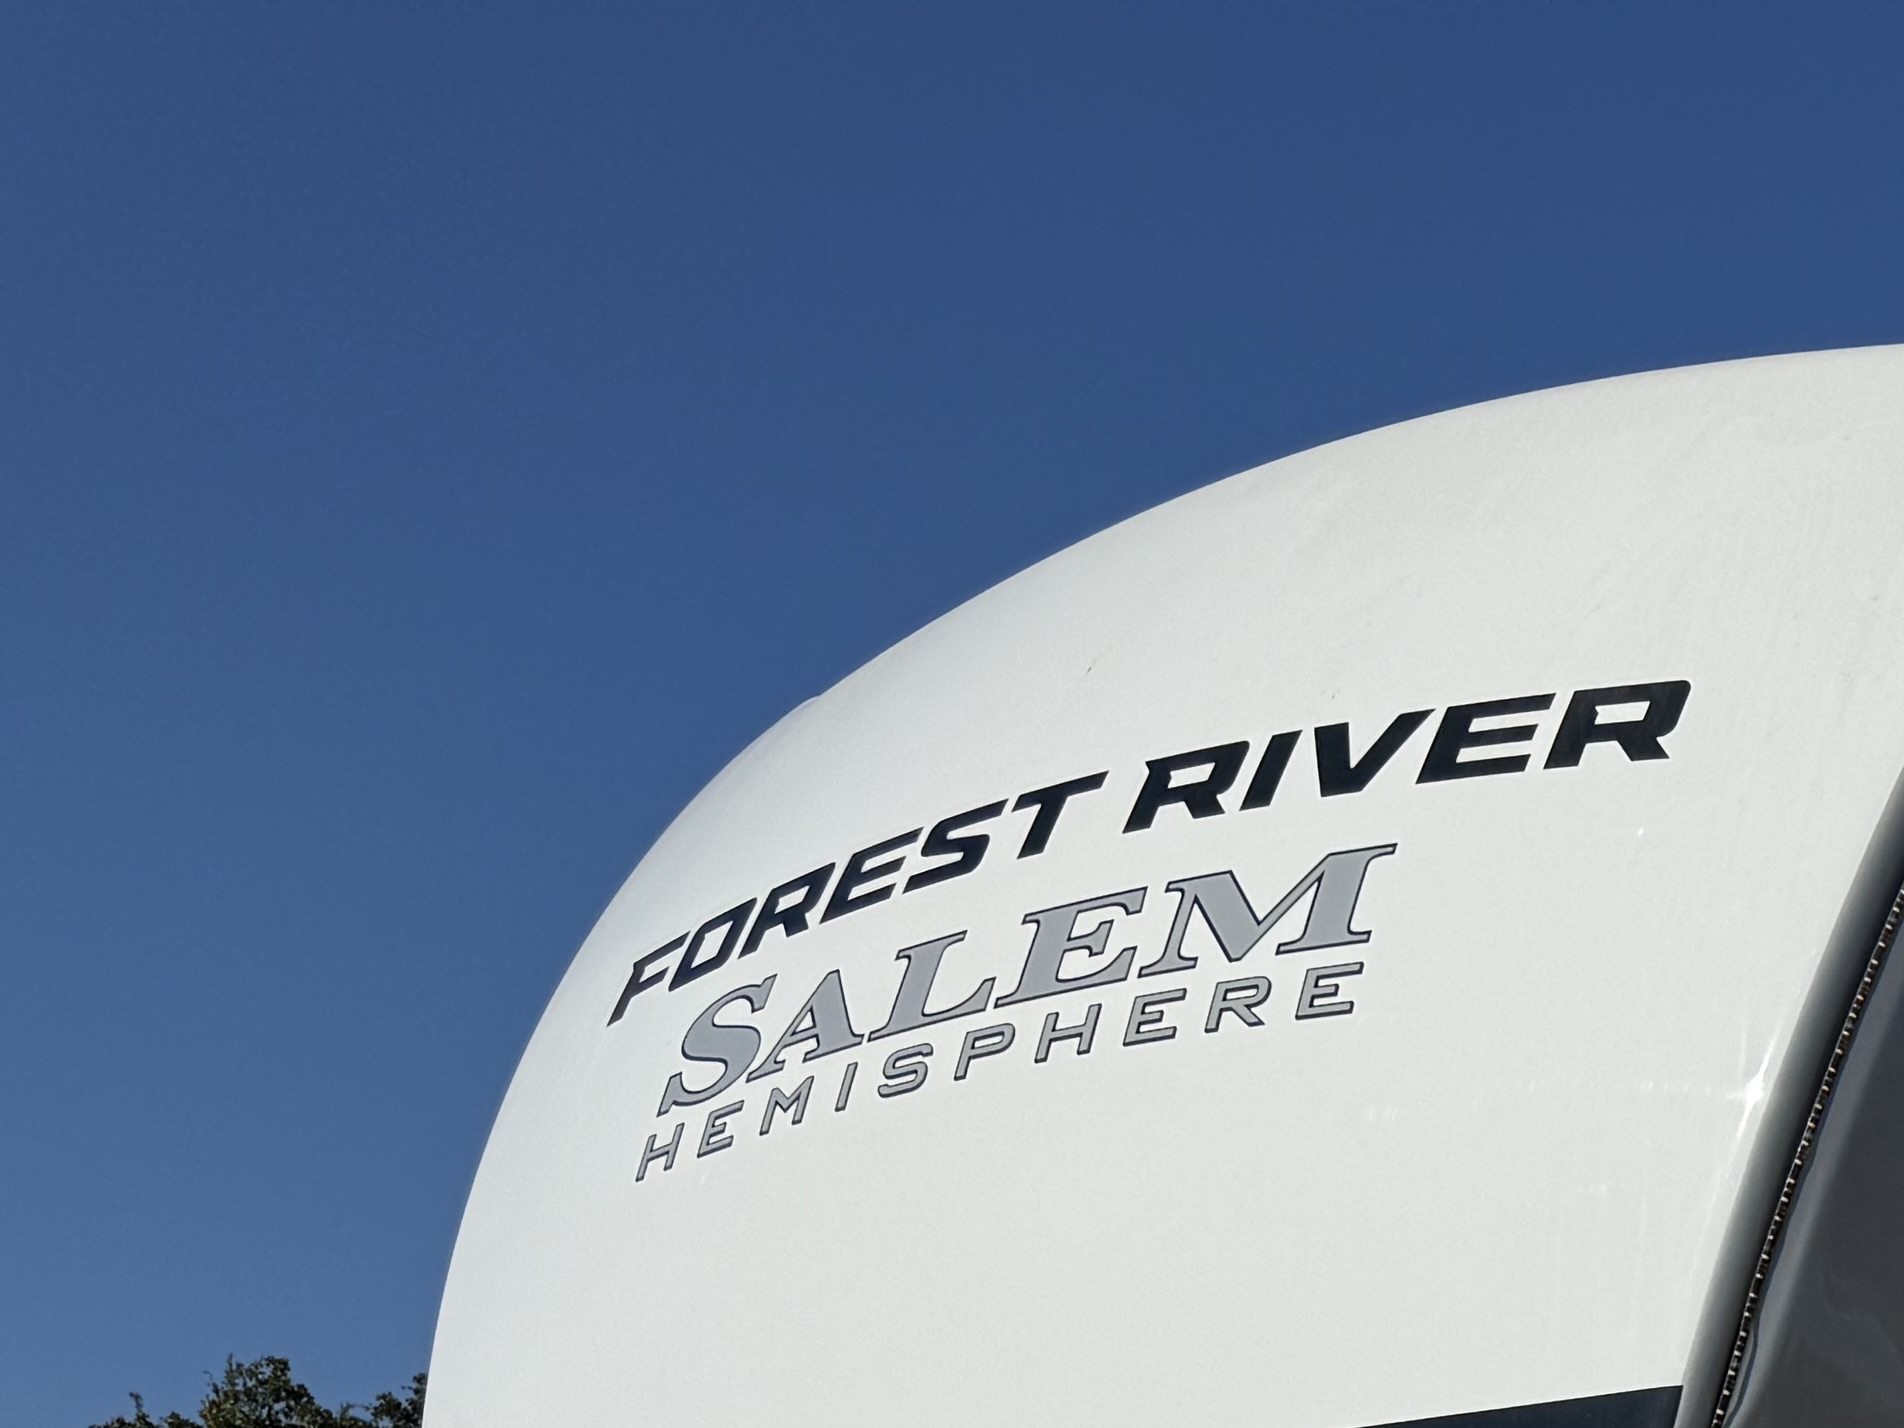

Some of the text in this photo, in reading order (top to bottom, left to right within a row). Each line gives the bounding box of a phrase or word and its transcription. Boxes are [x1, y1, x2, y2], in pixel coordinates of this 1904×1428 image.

[607, 678, 1692, 1026] FOREST RIVER
[656, 842, 1399, 1118] SALEM
[634, 959, 1366, 1183] HEMISPHERE
